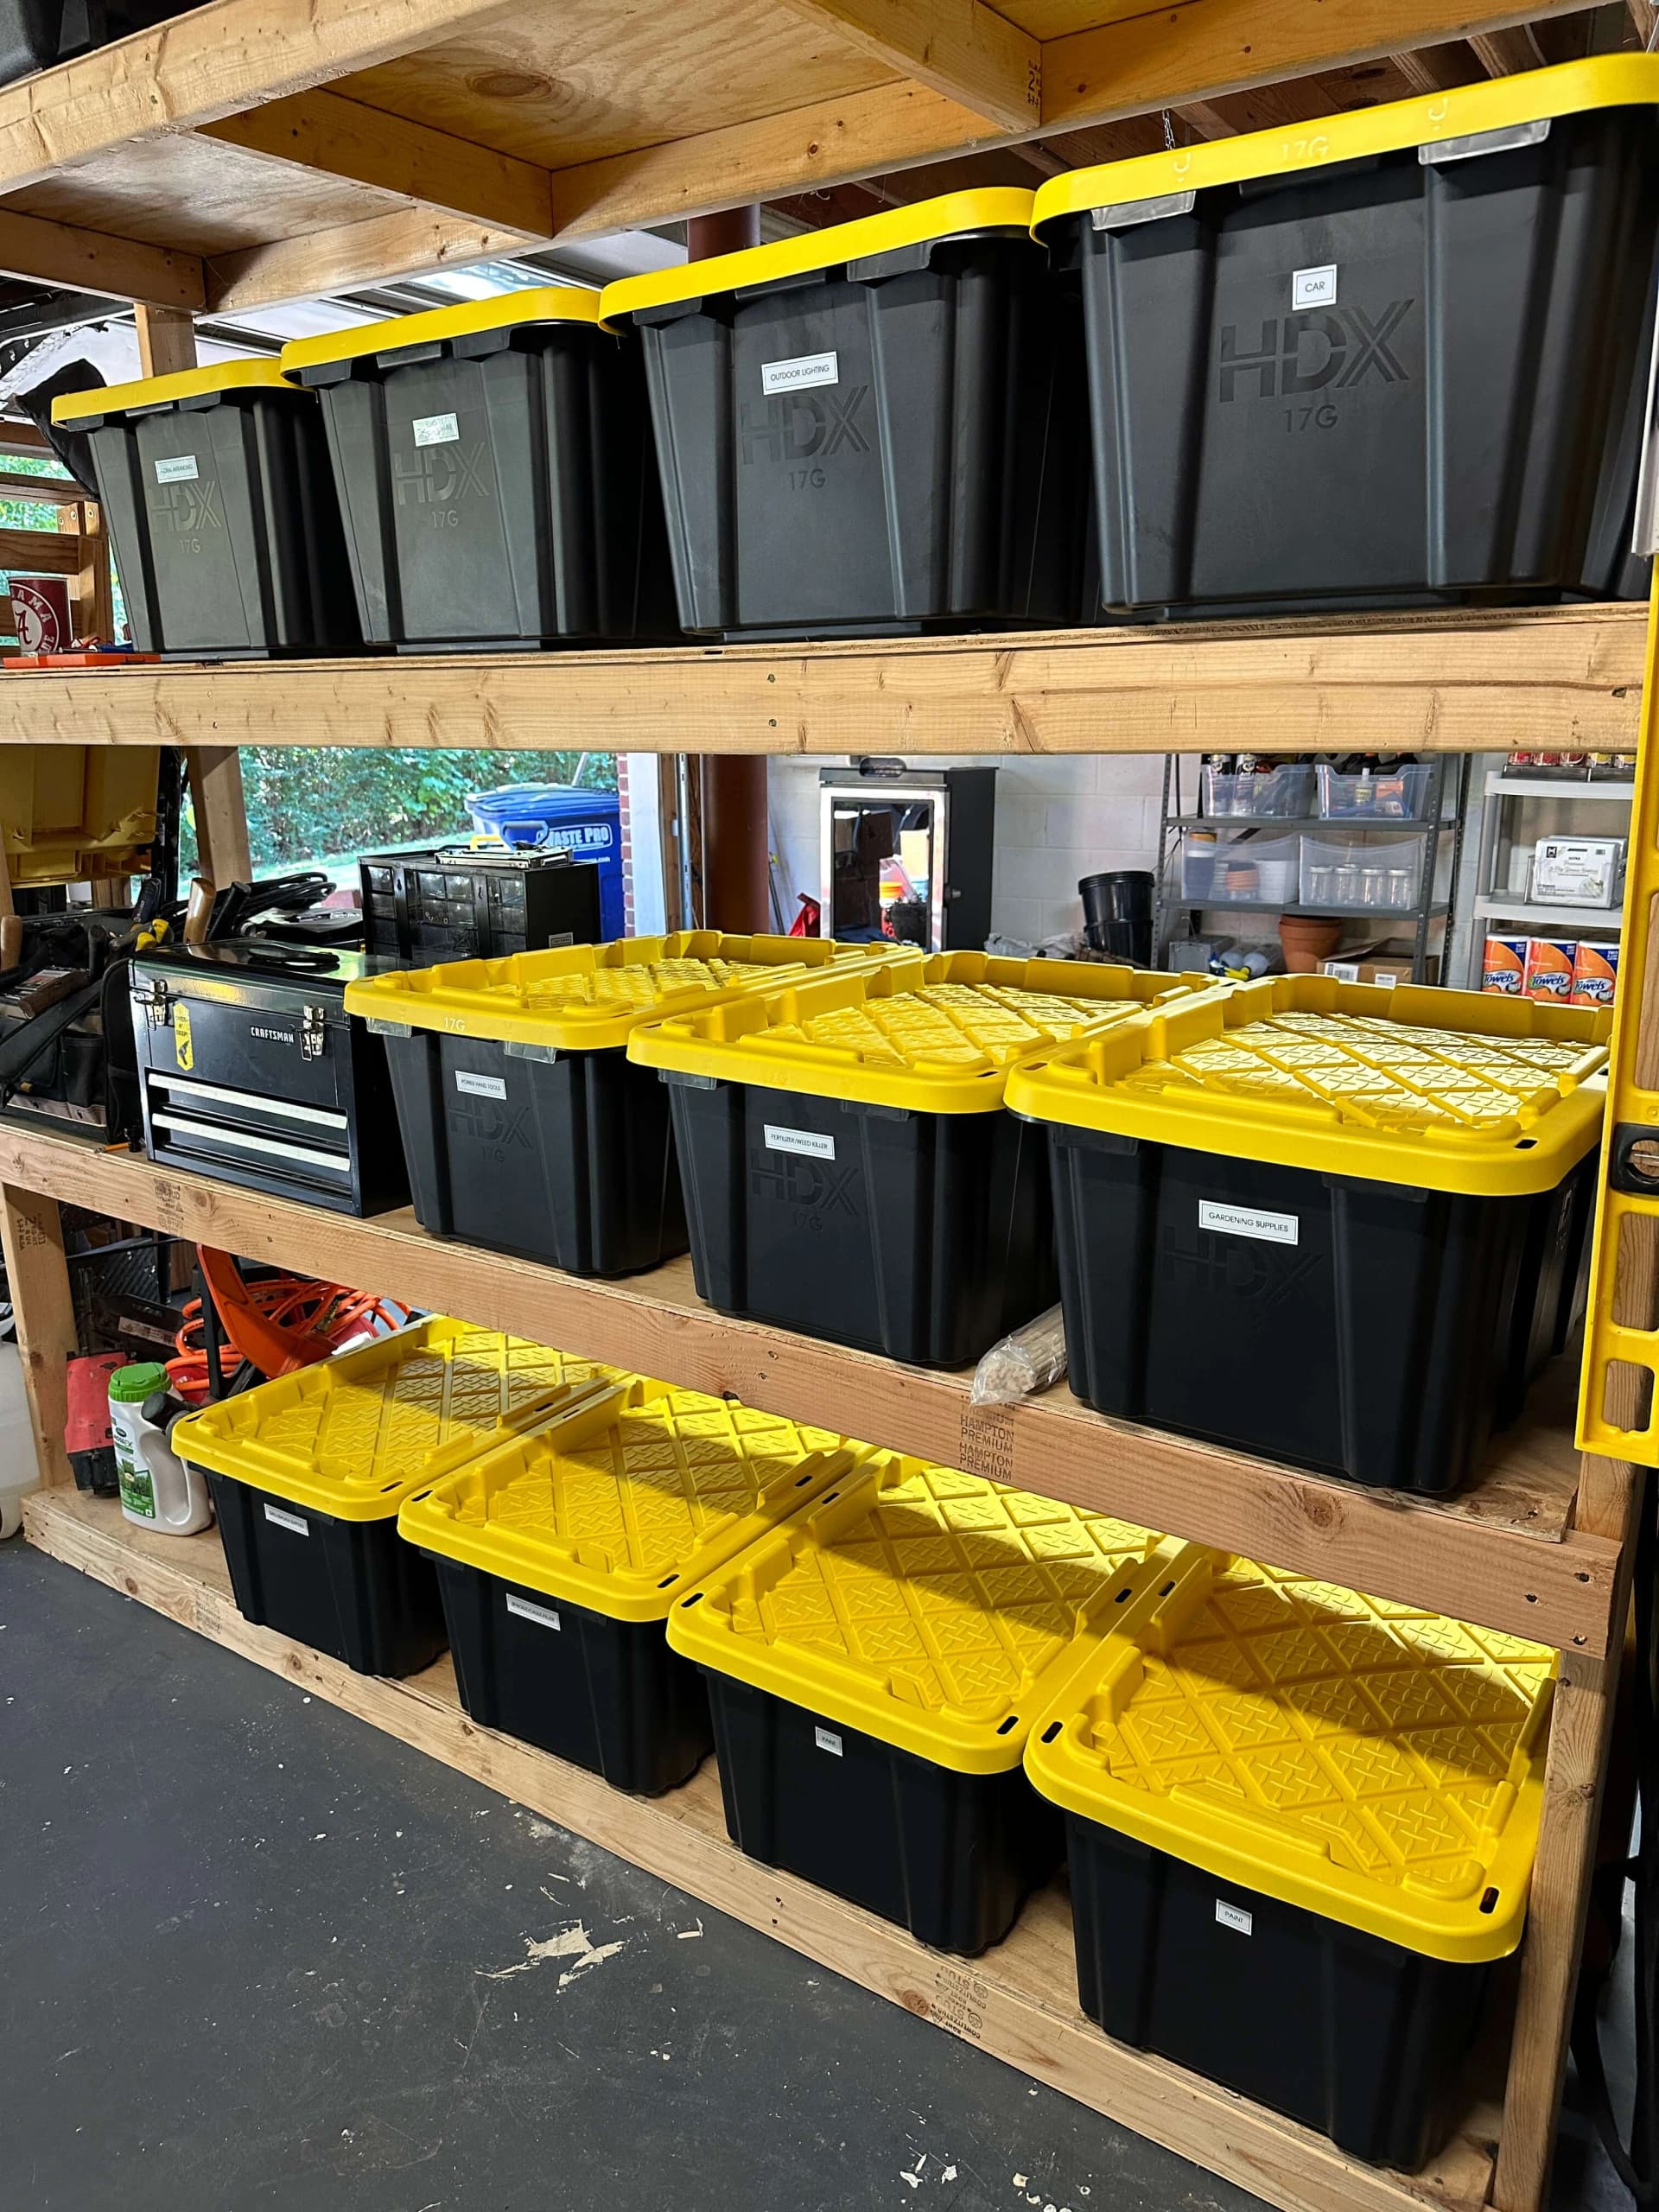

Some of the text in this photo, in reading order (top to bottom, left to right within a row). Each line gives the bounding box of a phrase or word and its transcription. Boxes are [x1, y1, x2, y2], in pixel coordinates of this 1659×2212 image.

[1281, 136, 1329, 160] 17G
[1305, 281, 1325, 293] CAR
[1219, 298, 1414, 403] HDX
[770, 364, 830, 382] OUTDOOR LIGHTING
[740, 385, 871, 466] HDX
[1284, 404, 1338, 432] 17G
[393, 442, 491, 505] HDX
[789, 467, 826, 492] 17G
[148, 480, 222, 533] HDX
[432, 509, 459, 528] 17G
[180, 538, 201, 554] 17G
[584, 826, 610, 843] PRO
[1484, 973, 1514, 983] Towels
[1532, 975, 1566, 988] Towels
[1574, 981, 1607, 992] Towels
[251, 1027, 295, 1043] CRAFTSMAN
[443, 1017, 466, 1032] 17G
[448, 1096, 534, 1149] HDX
[811, 1141, 829, 1150] KILLER
[751, 1148, 859, 1217] HDX
[1208, 1211, 1289, 1233] GARDENING SUPPLIES
[960, 1414, 1014, 1443] HAMPTON
[961, 1427, 1013, 1453] PREMIUM
[959, 1441, 1014, 1468] HAMPTON
[959, 1452, 1012, 1480] PREMIUM
[1224, 1910, 1243, 1923] PAINT
